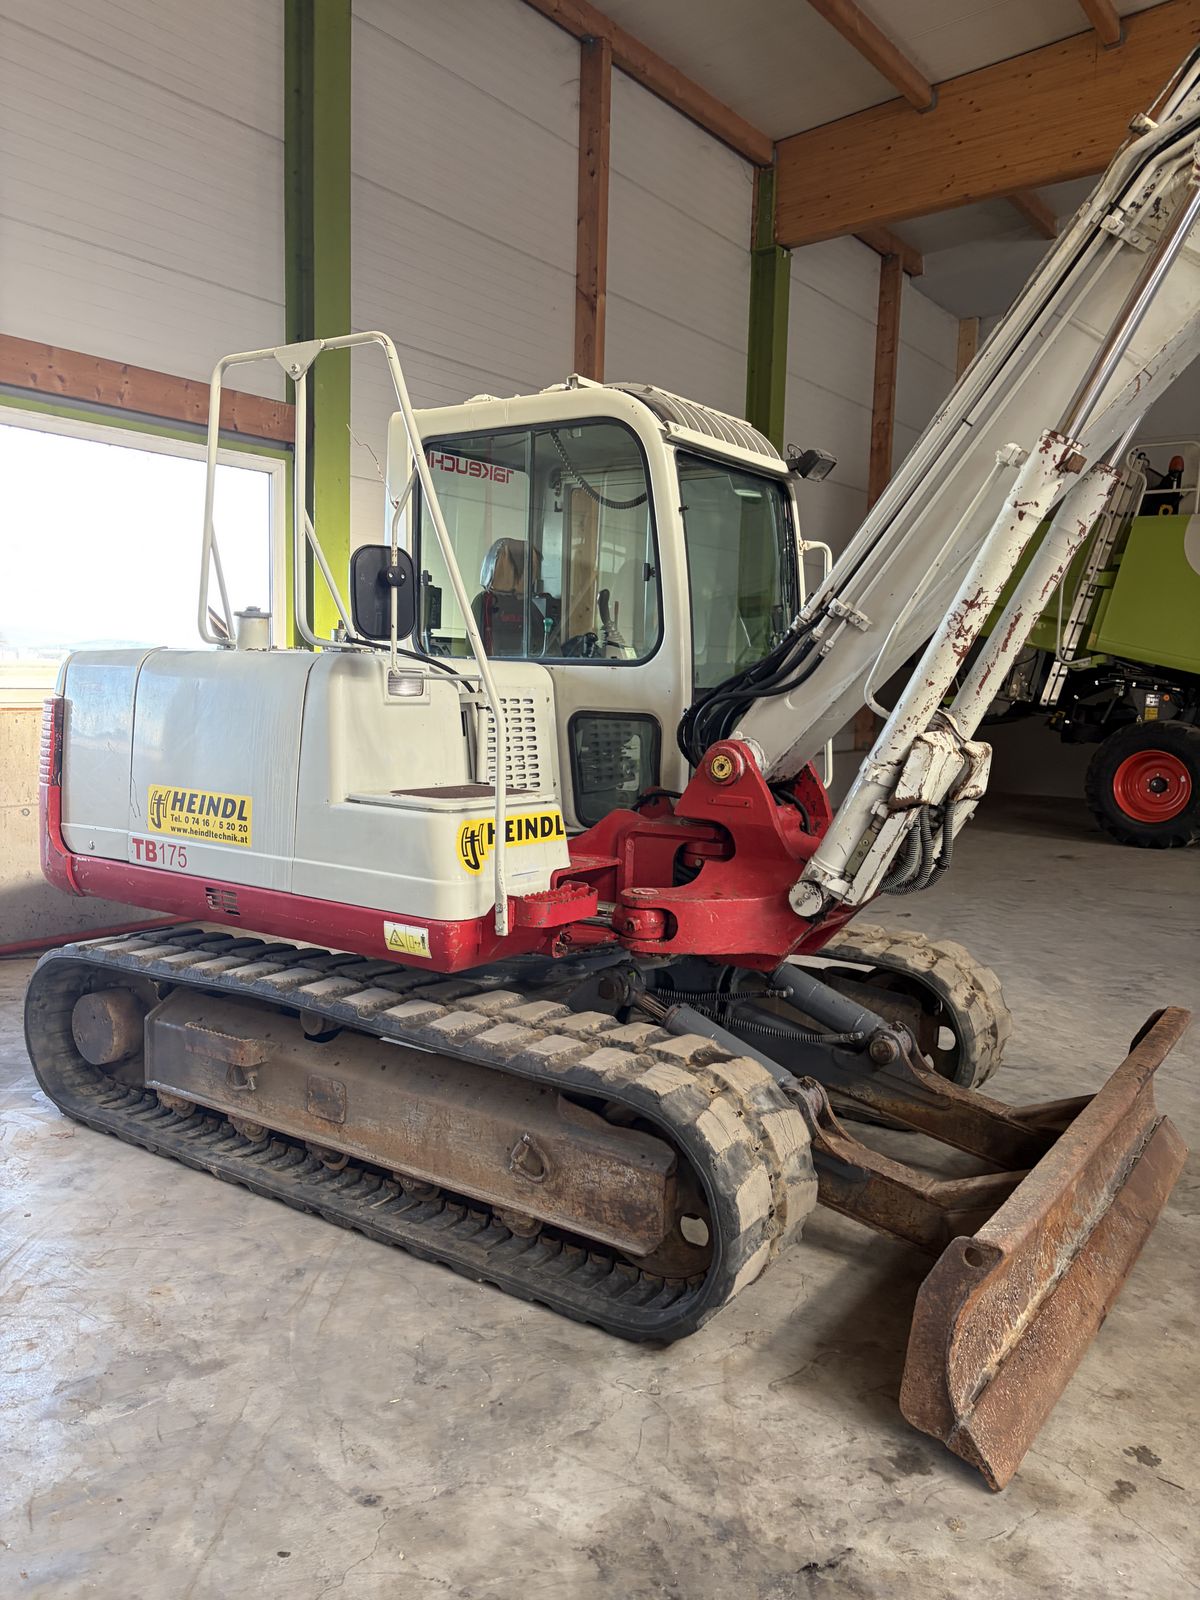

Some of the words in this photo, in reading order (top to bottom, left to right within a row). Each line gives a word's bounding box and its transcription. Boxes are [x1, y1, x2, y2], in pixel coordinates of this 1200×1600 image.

[170, 791, 248, 822] HEINDL
[170, 814, 183, 823] Tel.
[184, 816, 190, 824] 0
[191, 817, 200, 826] 74
[202, 819, 210, 827] 16
[218, 821, 224, 829] 5
[226, 822, 236, 831] 20
[238, 824, 248, 833] 20
[170, 825, 248, 844] www.heindltechnik.at
[132, 838, 188, 868] TB175
